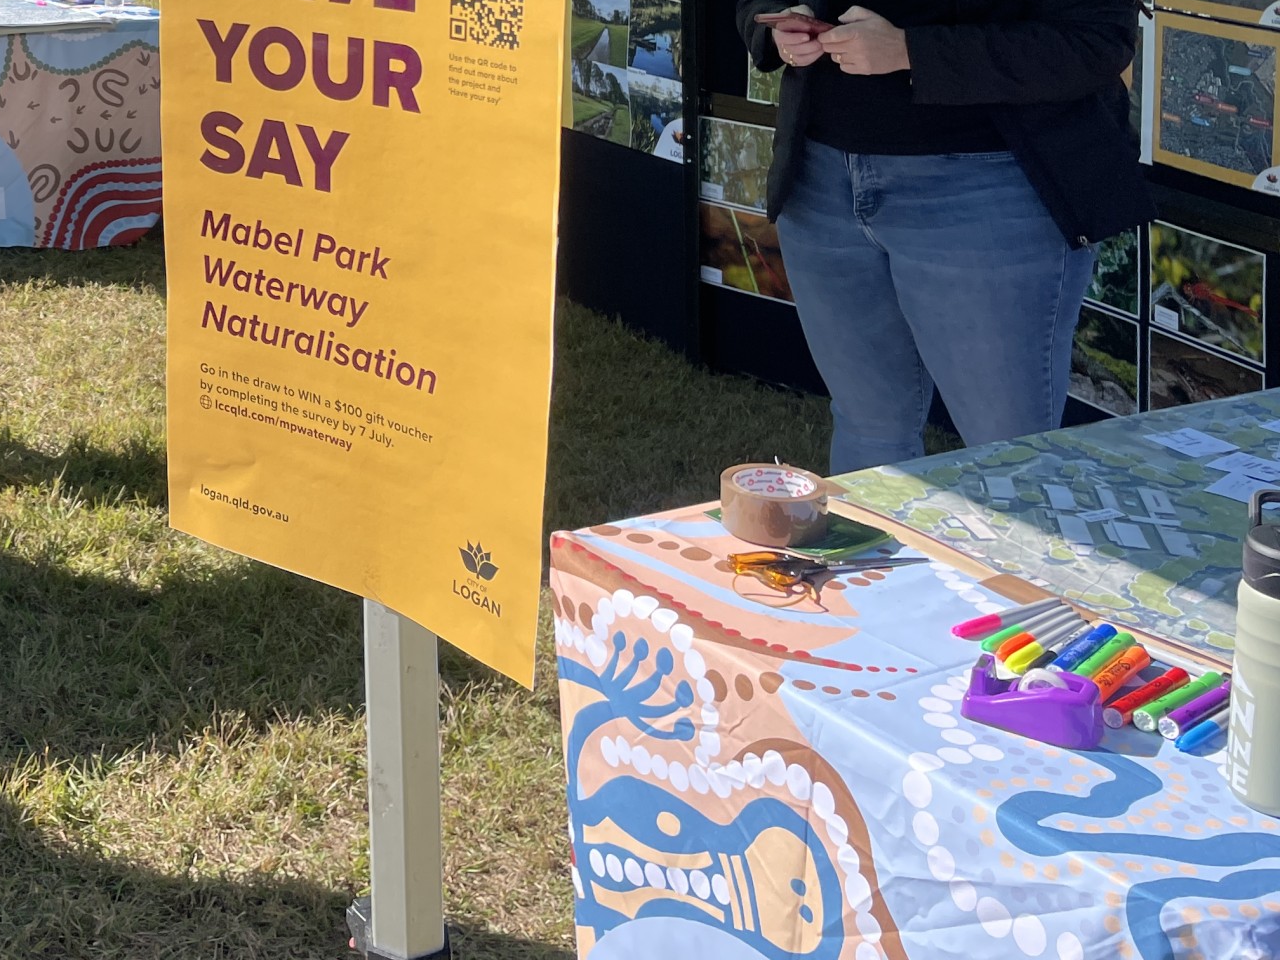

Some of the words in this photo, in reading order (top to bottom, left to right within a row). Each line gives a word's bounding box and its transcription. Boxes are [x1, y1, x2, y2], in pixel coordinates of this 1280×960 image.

[196, 18, 423, 114] YOUR
[448, 53, 463, 62] Use
[464, 56, 476, 65] the
[477, 58, 489, 67] QR
[490, 61, 508, 70] code
[509, 64, 517, 72] to
[448, 64, 463, 74] find
[463, 68, 476, 76] out
[477, 71, 496, 80] more
[497, 74, 518, 85] about
[448, 76, 460, 85] the
[461, 80, 486, 91] project
[487, 85, 501, 93] and
[469, 93, 486, 102] your
[199, 110, 350, 193] SAY
[200, 209, 304, 258] Mabel
[312, 232, 392, 280] Park
[203, 254, 369, 328] Waterway
[201, 300, 437, 395] Naturalisation
[200, 362, 216, 376] Go
[218, 366, 229, 379] in
[232, 371, 250, 385] the
[253, 377, 281, 393] draw
[284, 385, 295, 397] to
[298, 389, 321, 406] WIN
[325, 399, 331, 409] a
[334, 400, 363, 418] $100
[365, 411, 385, 427] gift
[387, 419, 433, 444] voucher
[200, 379, 213, 394] by
[216, 385, 278, 412] completing
[281, 401, 299, 416] the
[302, 408, 339, 430] survey
[342, 419, 357, 436] by
[359, 425, 366, 437] 7
[369, 429, 395, 448] July.
[215, 398, 353, 452] lccqld.com/mpwaterway
[200, 483, 290, 523] logan.qld.gov.au
[452, 579, 501, 618] LOGAN
[466, 577, 480, 589] CITY
